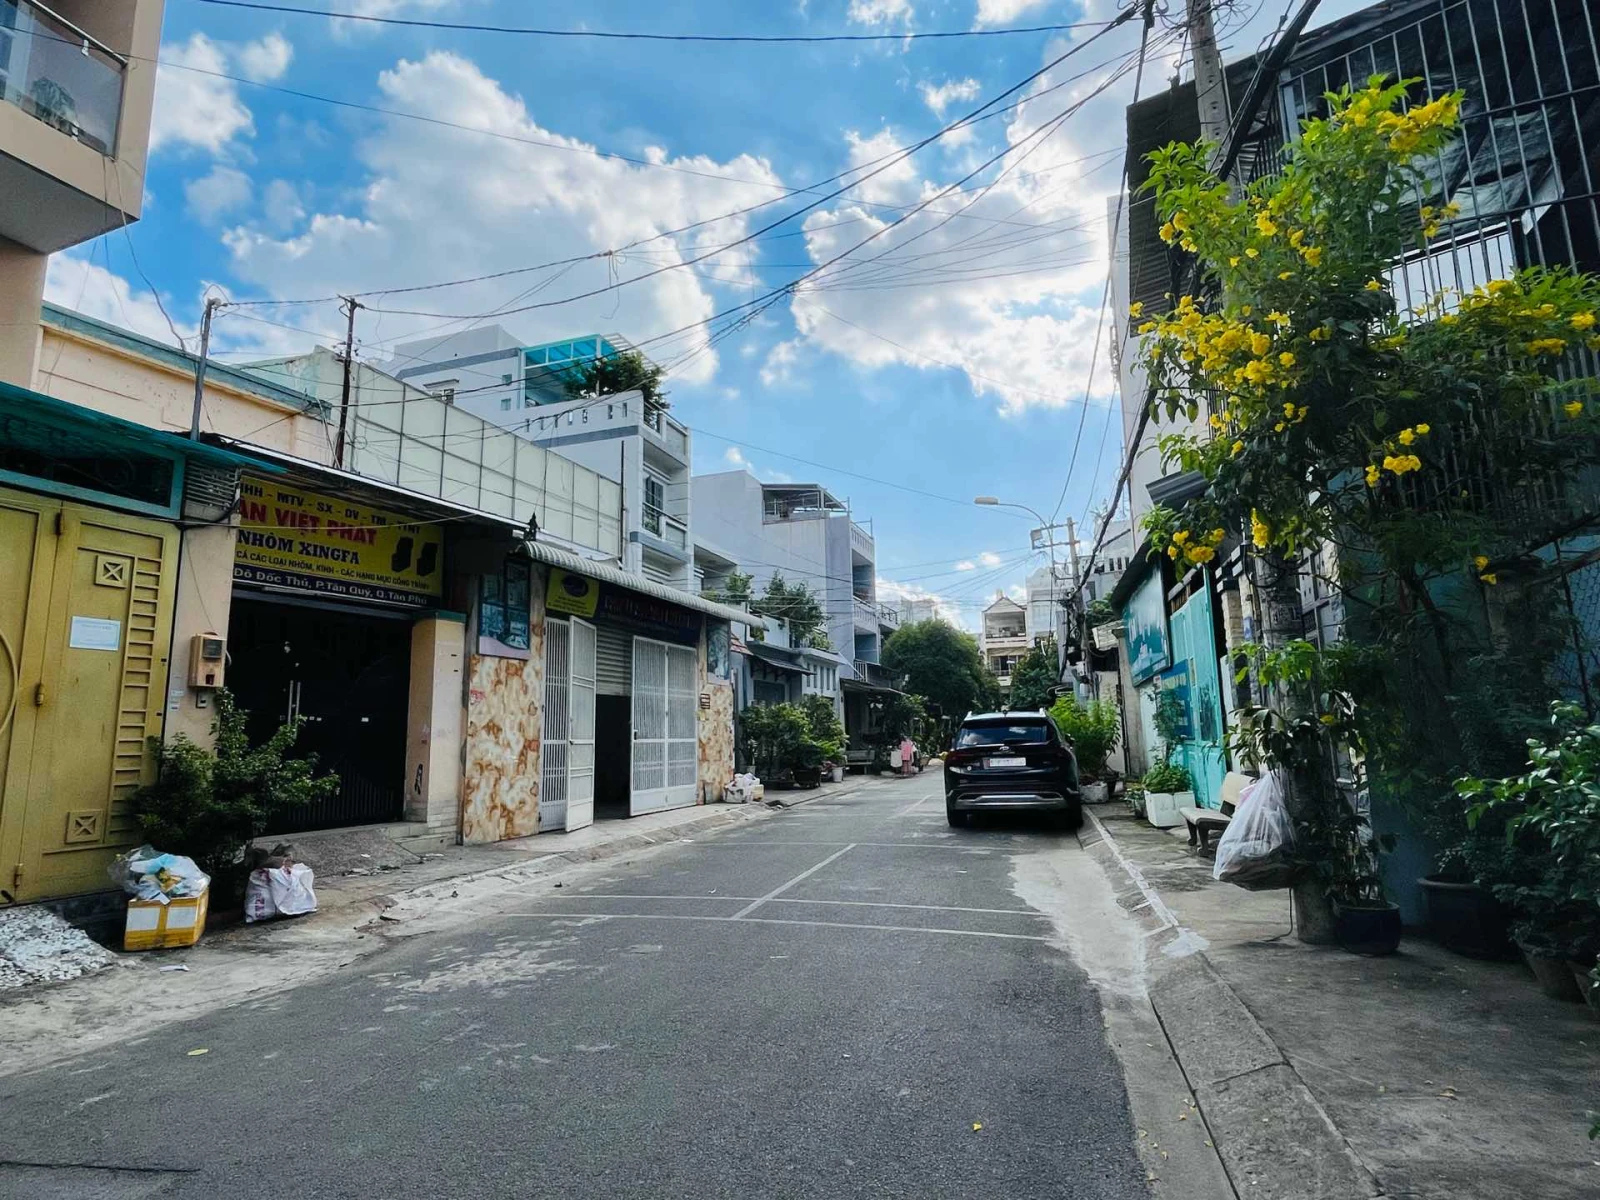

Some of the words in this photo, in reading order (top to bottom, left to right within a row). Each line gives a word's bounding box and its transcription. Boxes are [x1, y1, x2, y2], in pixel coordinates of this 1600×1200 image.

[277, 493, 304, 506] MTV
[316, 502, 332, 514] SX
[275, 508, 320, 536] VIỆT
[327, 519, 377, 545] PHÁT
[237, 530, 293, 553] NHÔM
[298, 542, 360, 564] XINGFA
[234, 568, 252, 579] Đô
[256, 572, 281, 583] Đốc
